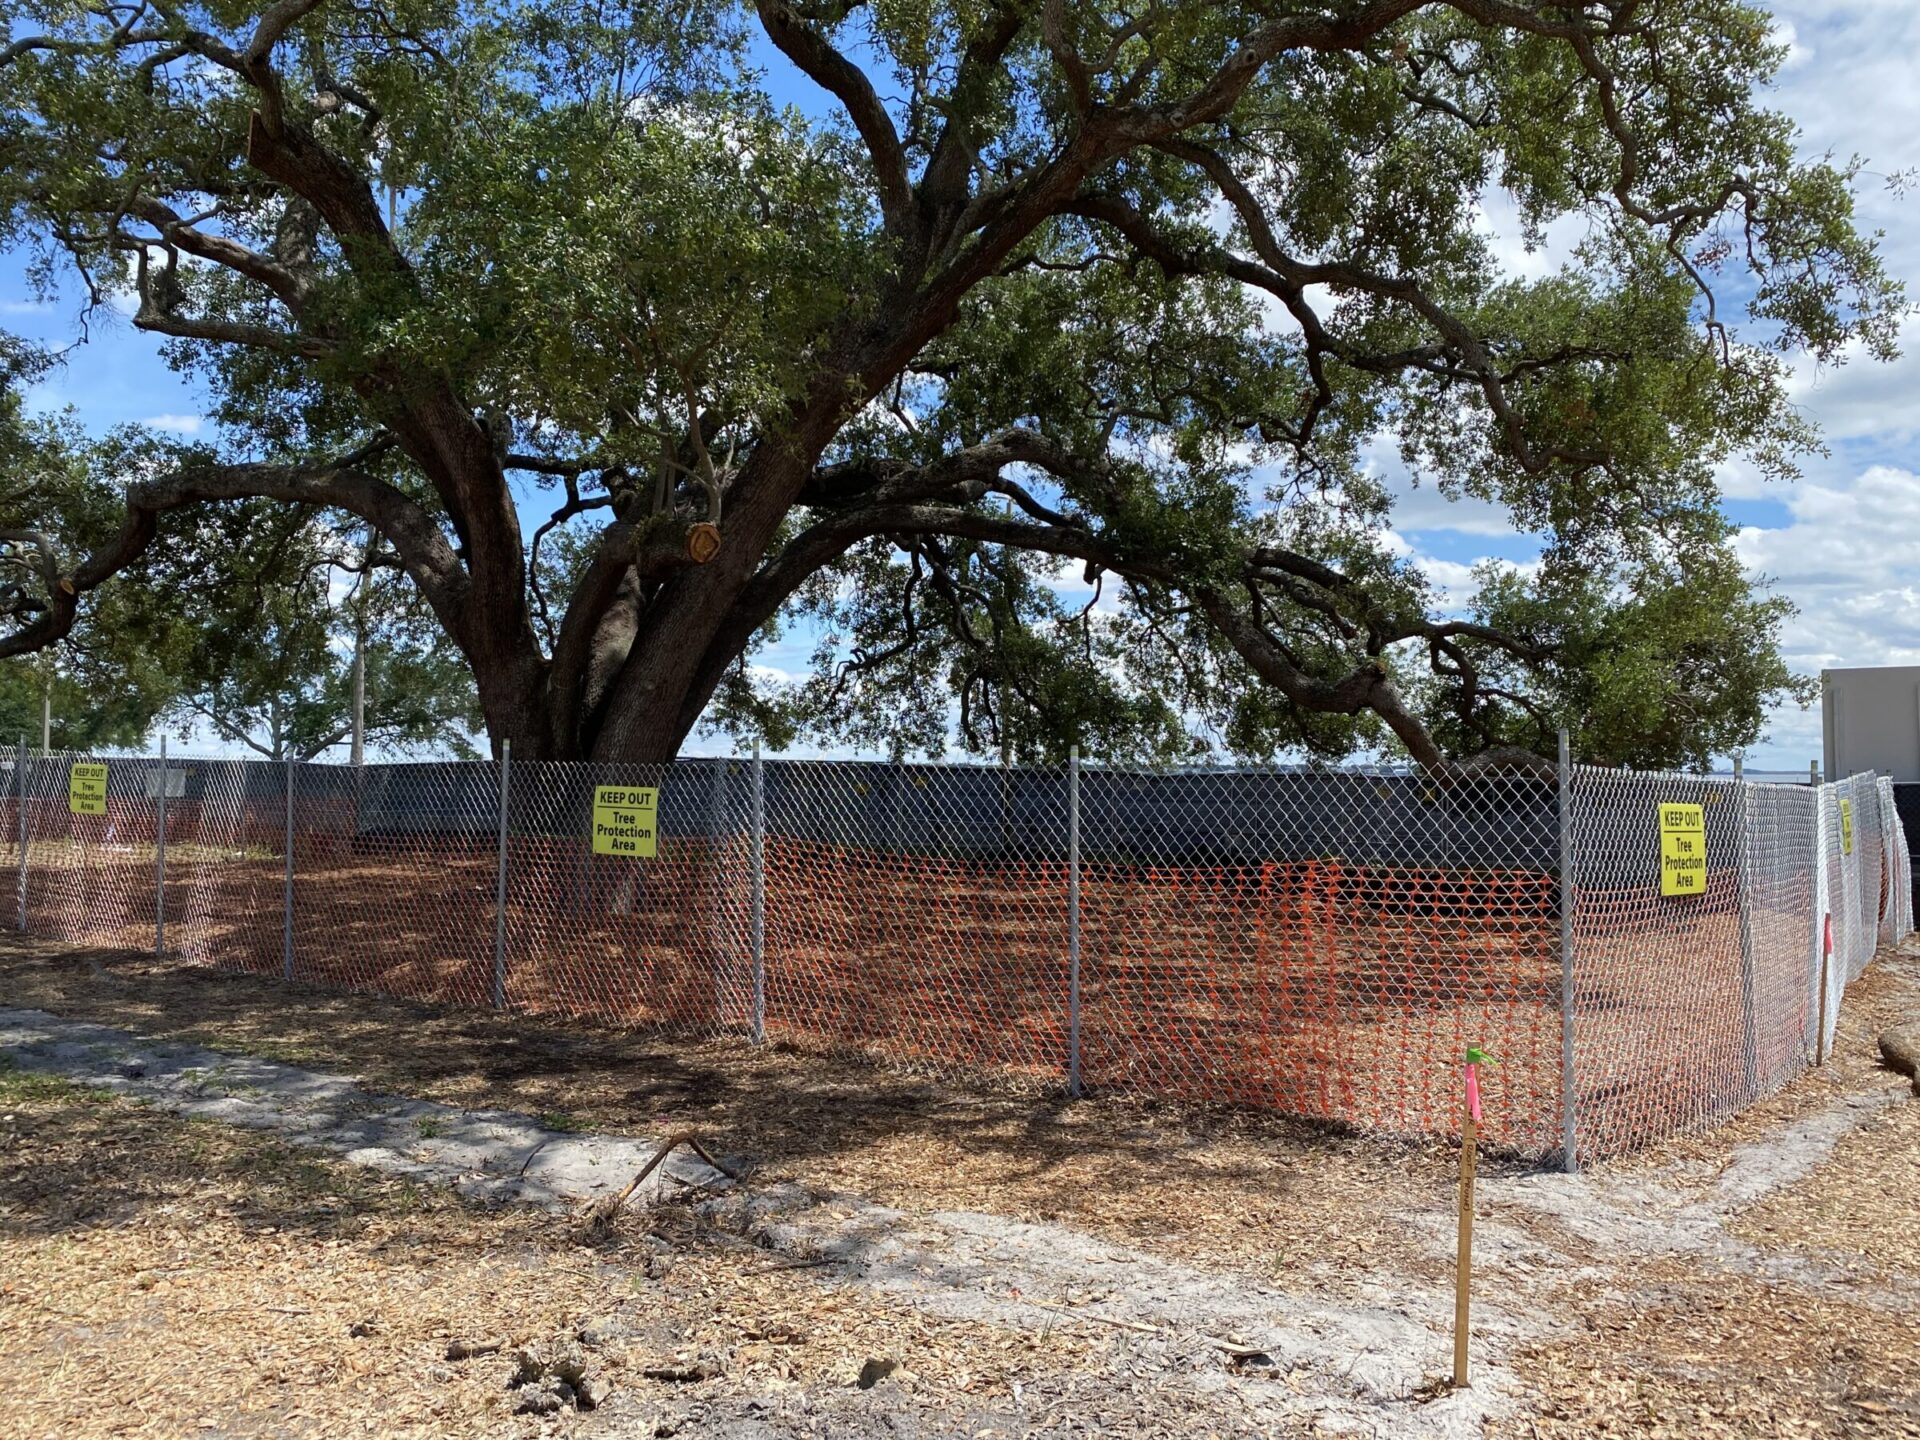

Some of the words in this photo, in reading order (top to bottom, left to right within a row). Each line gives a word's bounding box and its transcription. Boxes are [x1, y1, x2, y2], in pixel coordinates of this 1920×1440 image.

[74, 768, 89, 776] KEEP
[90, 769, 104, 777] OUT
[82, 782, 94, 791] Tree
[73, 791, 103, 801] Protection
[600, 792, 625, 804] KEEP
[628, 792, 651, 805] OUT
[81, 801, 94, 810] Area
[613, 811, 635, 824] Tree
[1665, 811, 1683, 826] KEEP
[1685, 811, 1699, 826] OUT
[597, 824, 651, 838] Protection
[611, 838, 636, 851] Area
[1676, 837, 1692, 852] Tree
[1665, 854, 1703, 871] Protection
[1676, 872, 1693, 887] Area
